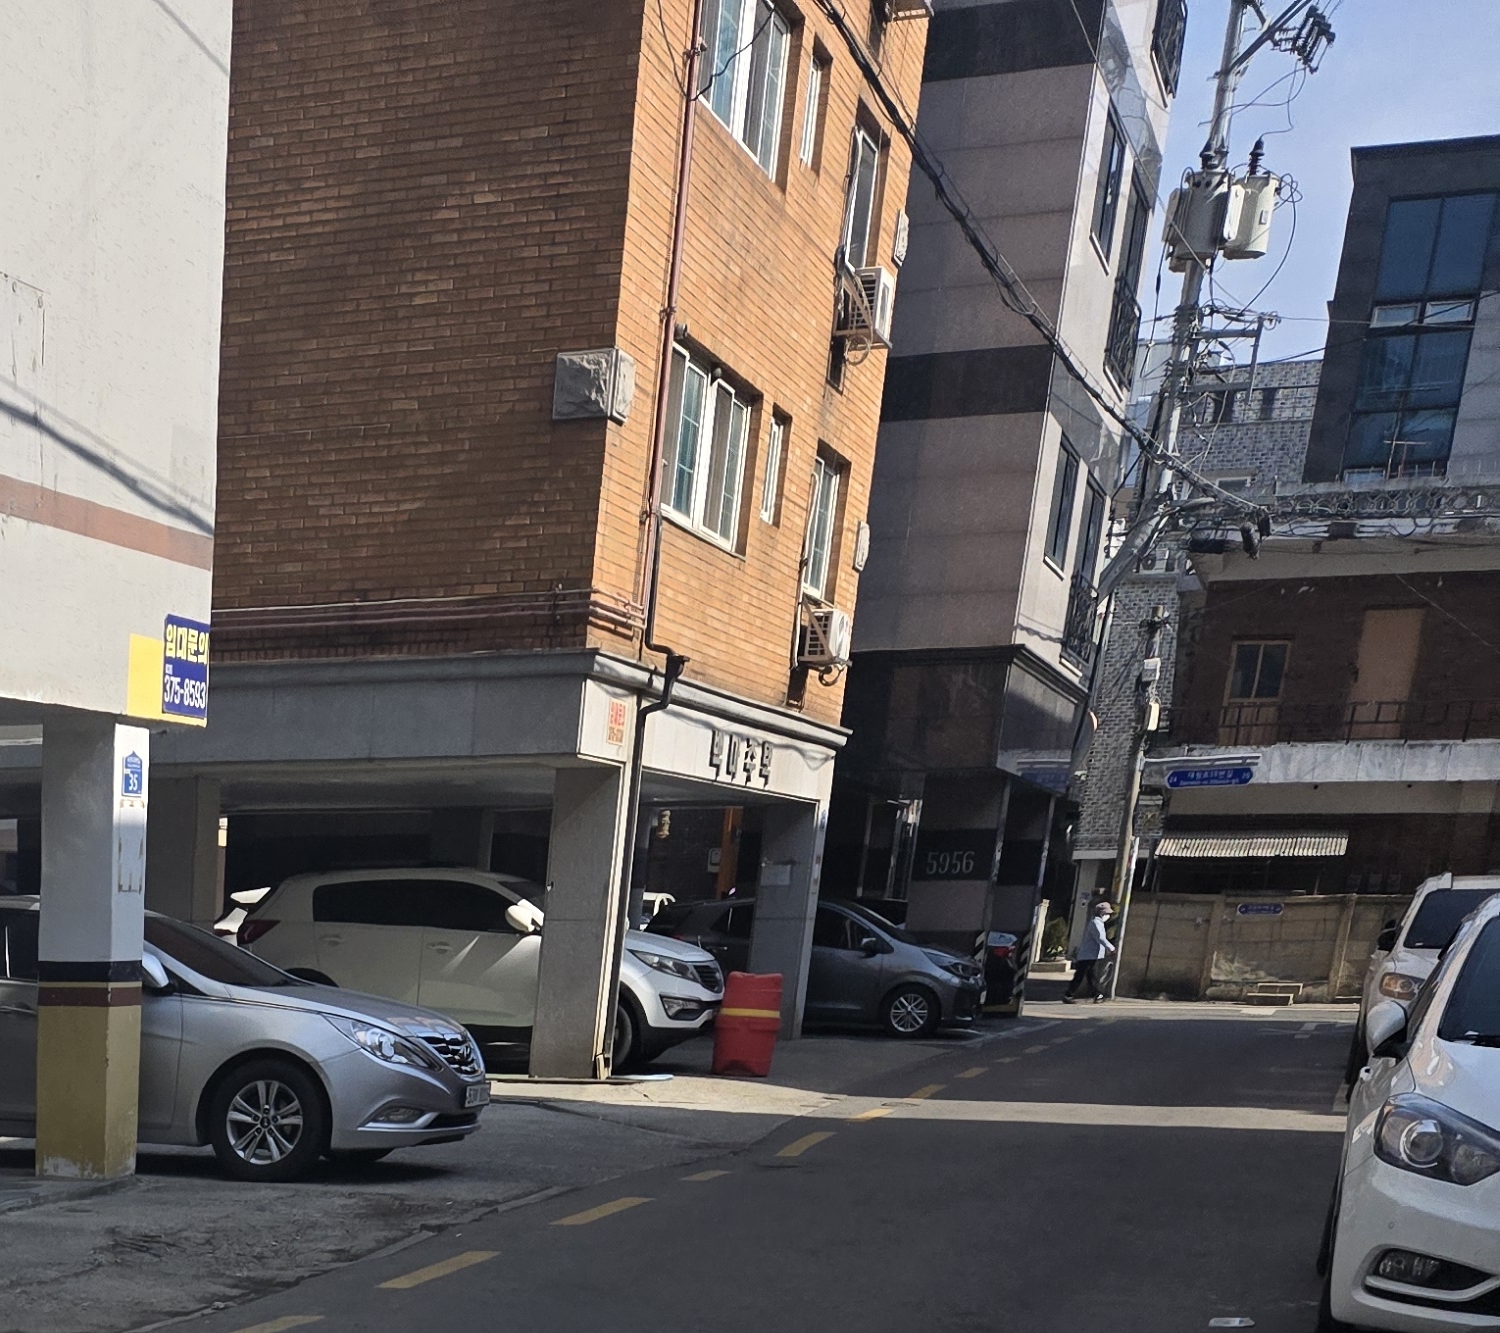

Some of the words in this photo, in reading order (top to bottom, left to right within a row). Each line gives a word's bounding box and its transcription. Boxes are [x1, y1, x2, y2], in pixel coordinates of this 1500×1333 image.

[165, 624, 209, 665] 임대문의
[164, 675, 206, 709] 375-8593
[128, 773, 138, 791] 35
[926, 851, 975, 874] 5956
